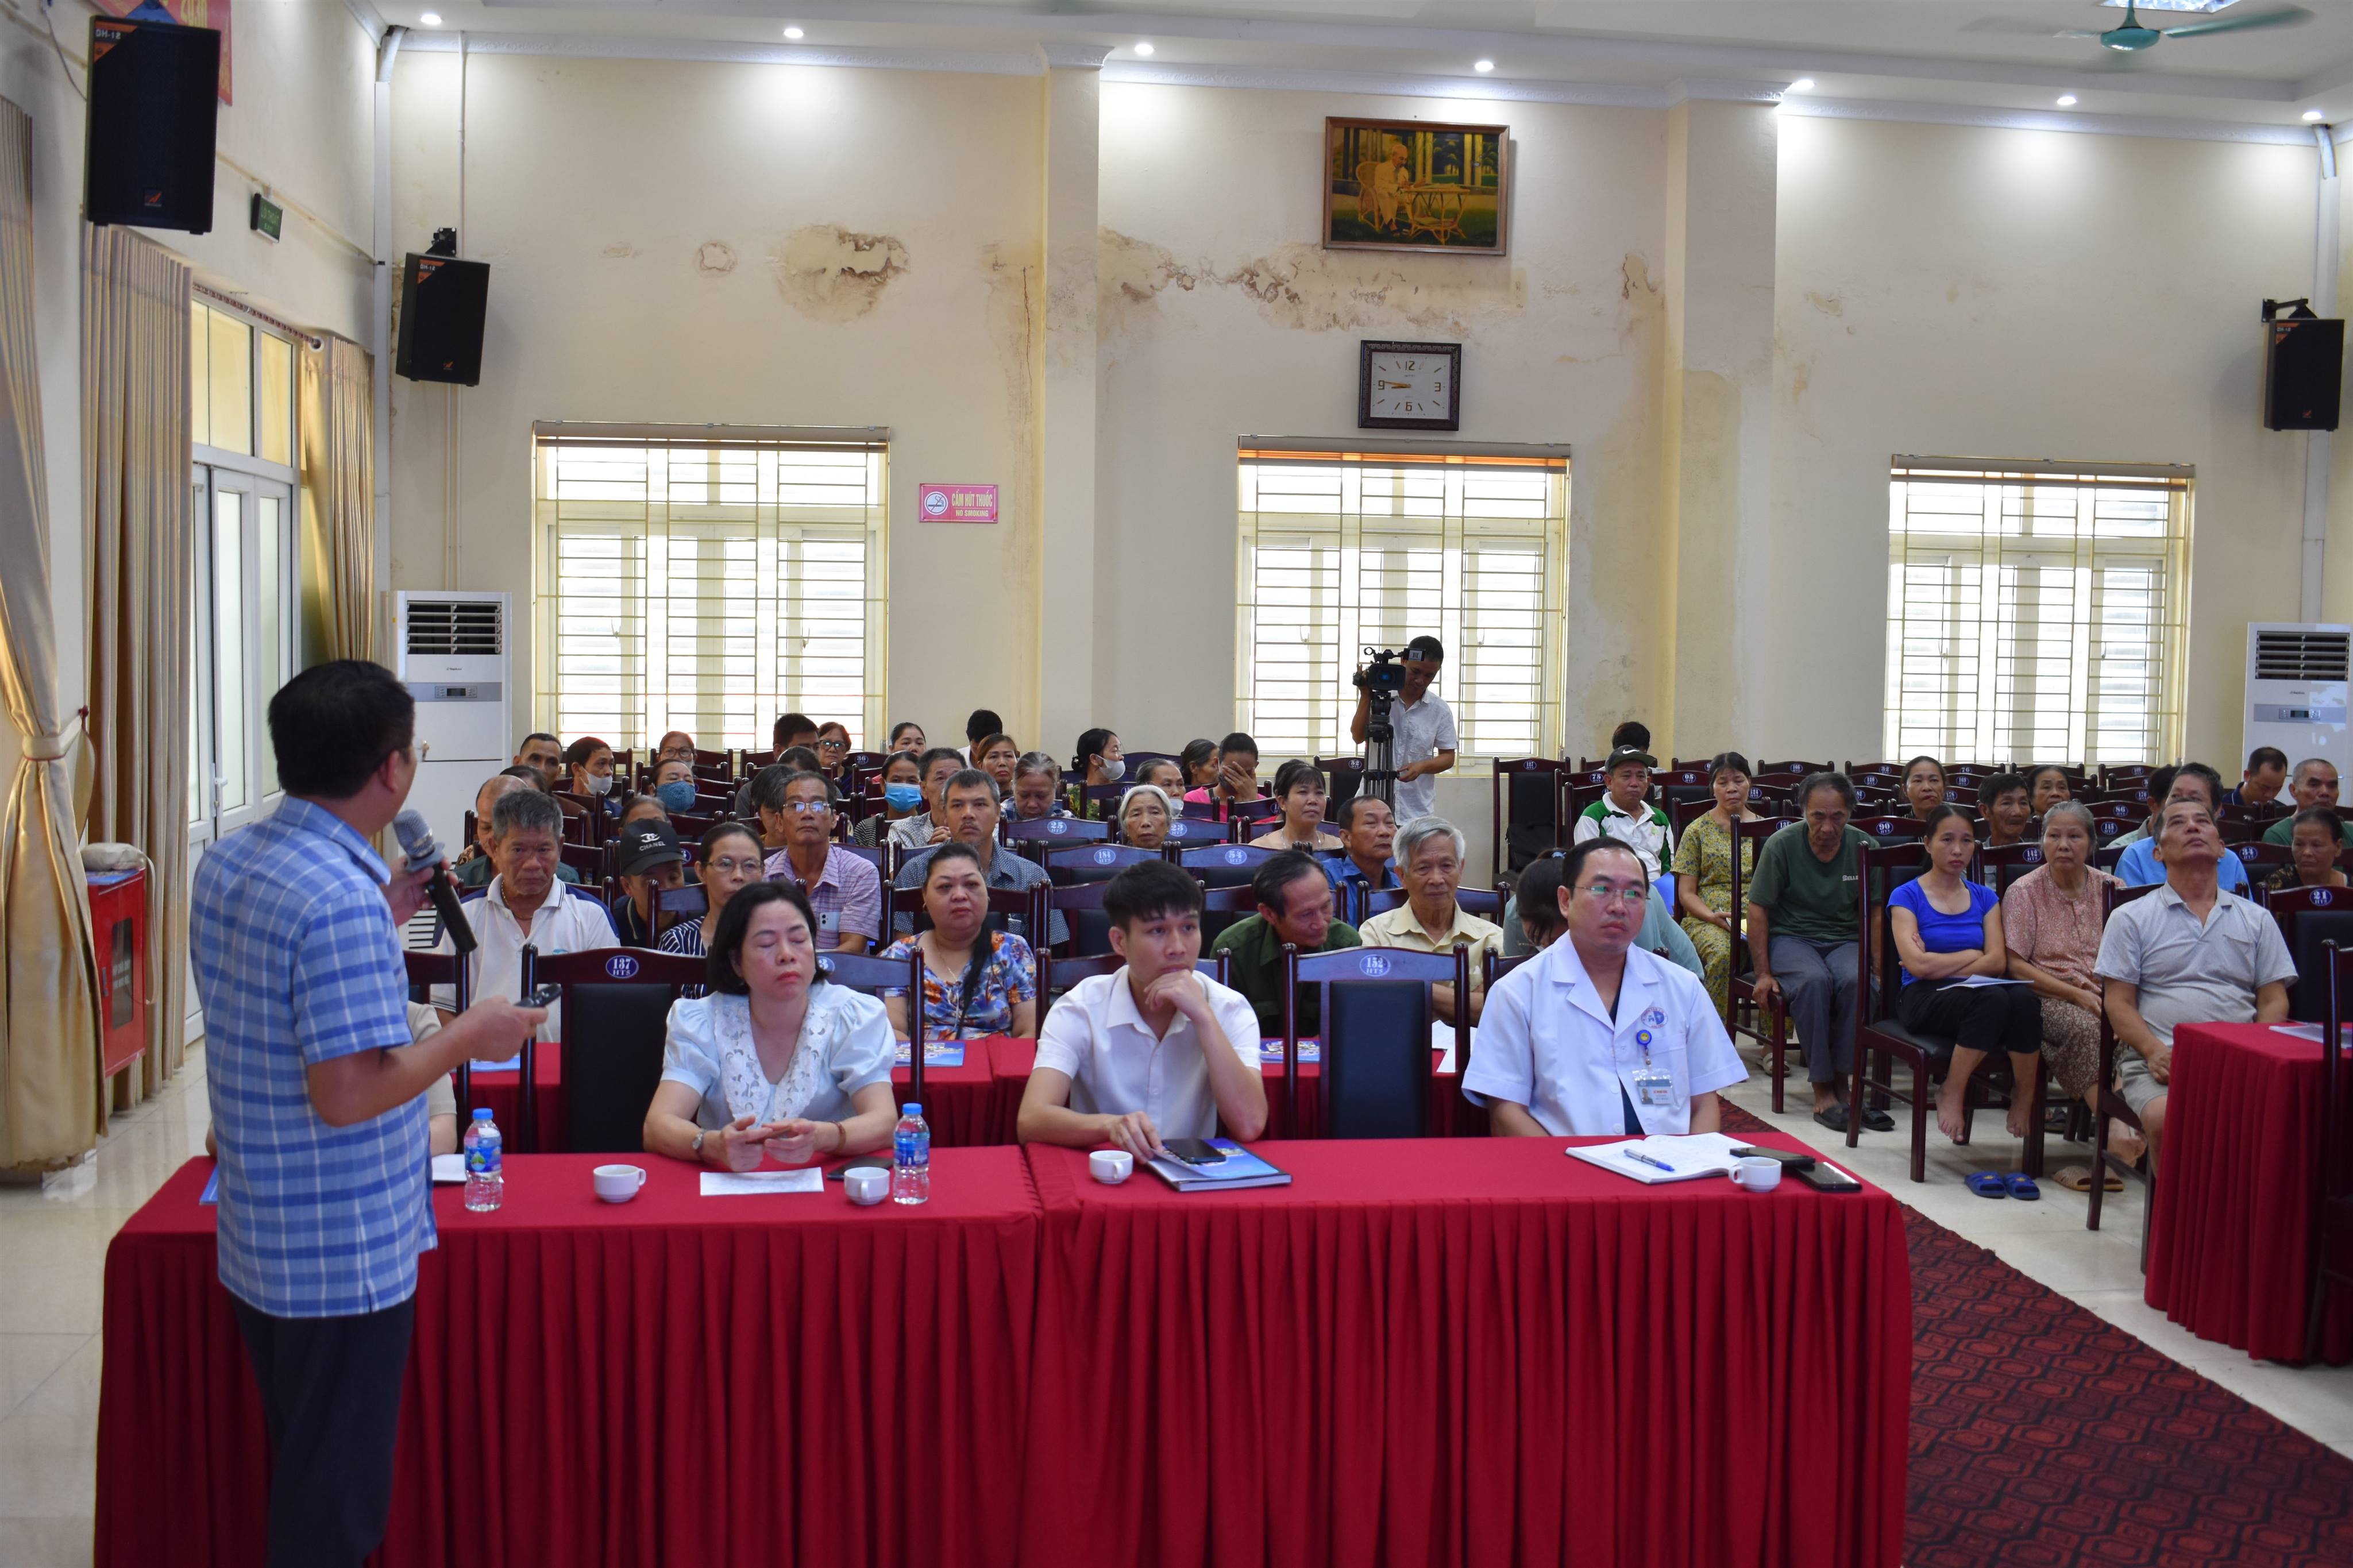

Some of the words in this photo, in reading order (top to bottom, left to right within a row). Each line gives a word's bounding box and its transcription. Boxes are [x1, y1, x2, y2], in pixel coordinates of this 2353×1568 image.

[1405, 361, 1415, 371] 12
[1378, 380, 1385, 390] 9
[1434, 382, 1441, 392] 3
[1405, 401, 1413, 411] 6
[952, 489, 964, 507] CẤM
[965, 491, 975, 507] HÚT
[976, 489, 993, 507] THUỐC
[639, 841, 666, 851] CHANEL
[1229, 850, 1242, 858] 54
[2313, 891, 2327, 899] 21
[613, 957, 631, 970] 137
[1366, 956, 1384, 968] 152
